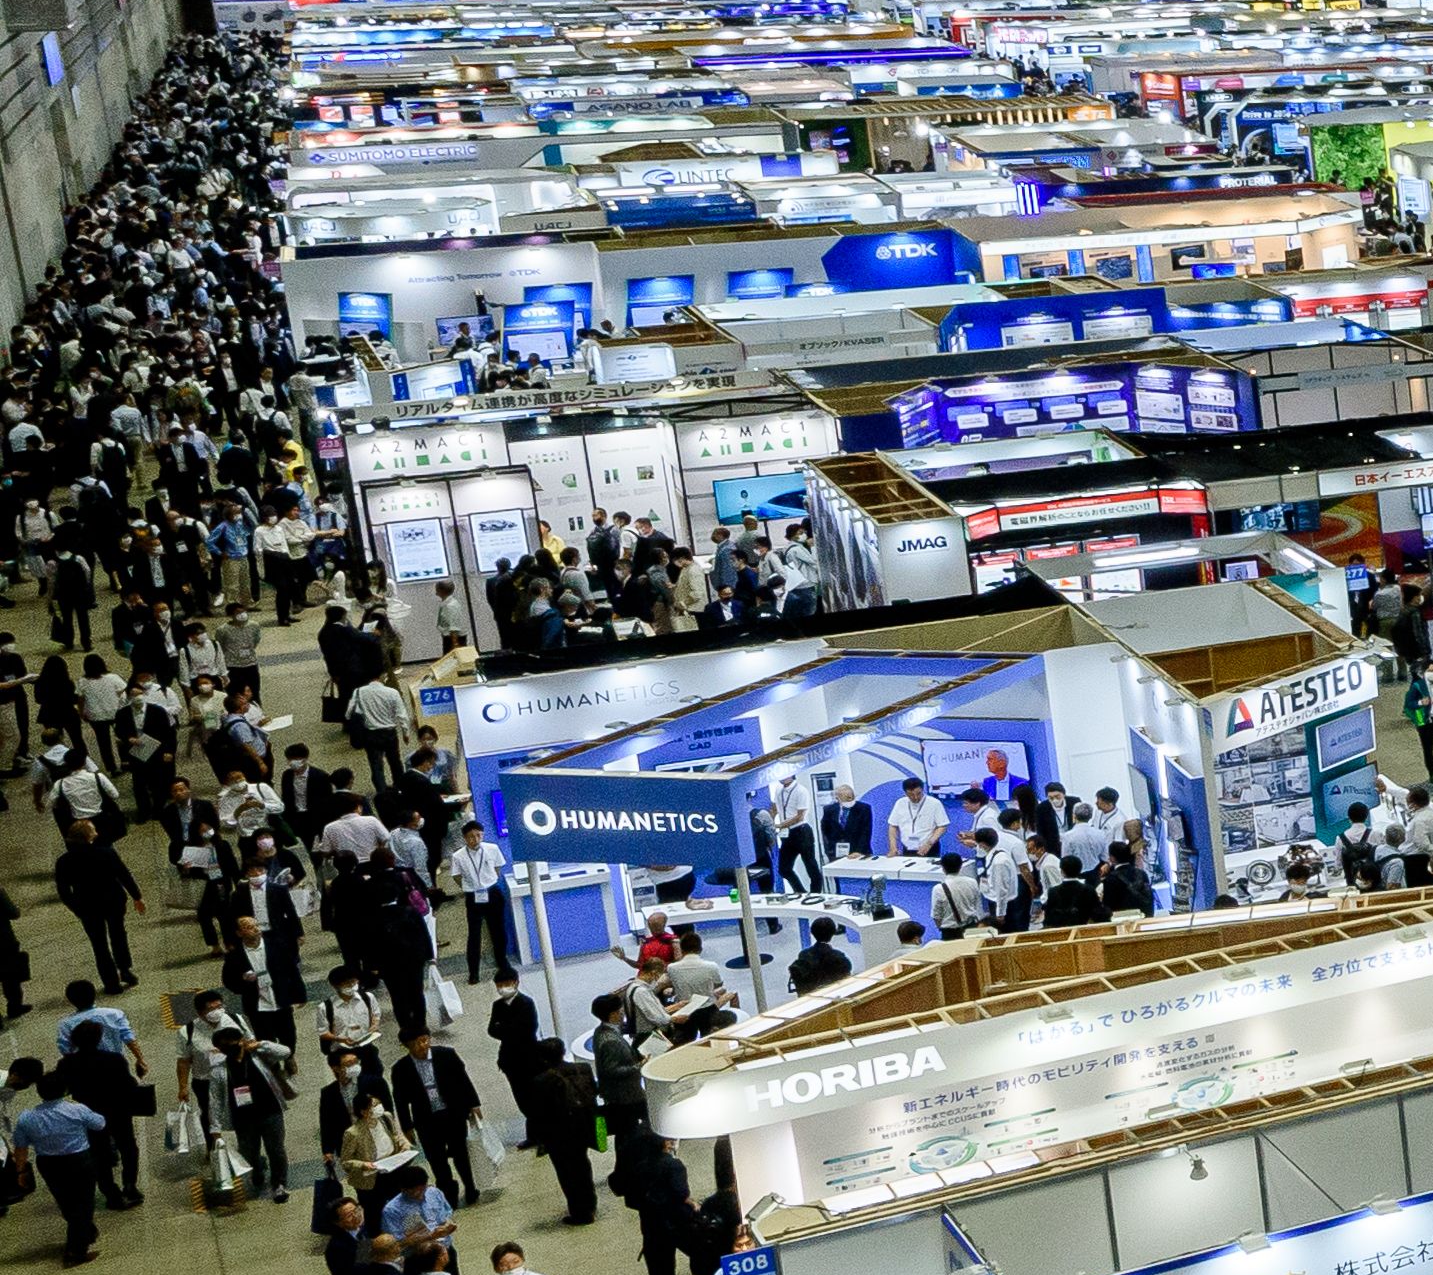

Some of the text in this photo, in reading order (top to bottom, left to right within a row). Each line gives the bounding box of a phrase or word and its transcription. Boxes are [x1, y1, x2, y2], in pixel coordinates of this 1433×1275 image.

[328, 144, 477, 163] SUMITOMO ELECTRIC
[679, 169, 735, 184] LINTEC
[534, 221, 572, 232] UACJ
[893, 242, 938, 259] TDK
[408, 269, 541, 285] Attracting Tomorrow TDK
[532, 305, 558, 318] TDK
[698, 420, 806, 443] A2MAC1
[370, 432, 484, 455] A2MAC1
[897, 535, 948, 554] JMAG
[424, 690, 451, 704] 276
[518, 679, 682, 715] HUMANETICS
[1260, 661, 1362, 725] ATESTEO
[1254, 701, 1340, 737] アテステオジャパン株式会社
[689, 741, 713, 752] CAD
[560, 806, 719, 834] HUMANETICS
[1119, 973, 1294, 1023] ひろがるクルマの未来
[742, 1045, 946, 1114] HORIBA
[903, 1034, 1200, 1112] 新エネルギー時代のモビリティ開発を支える
